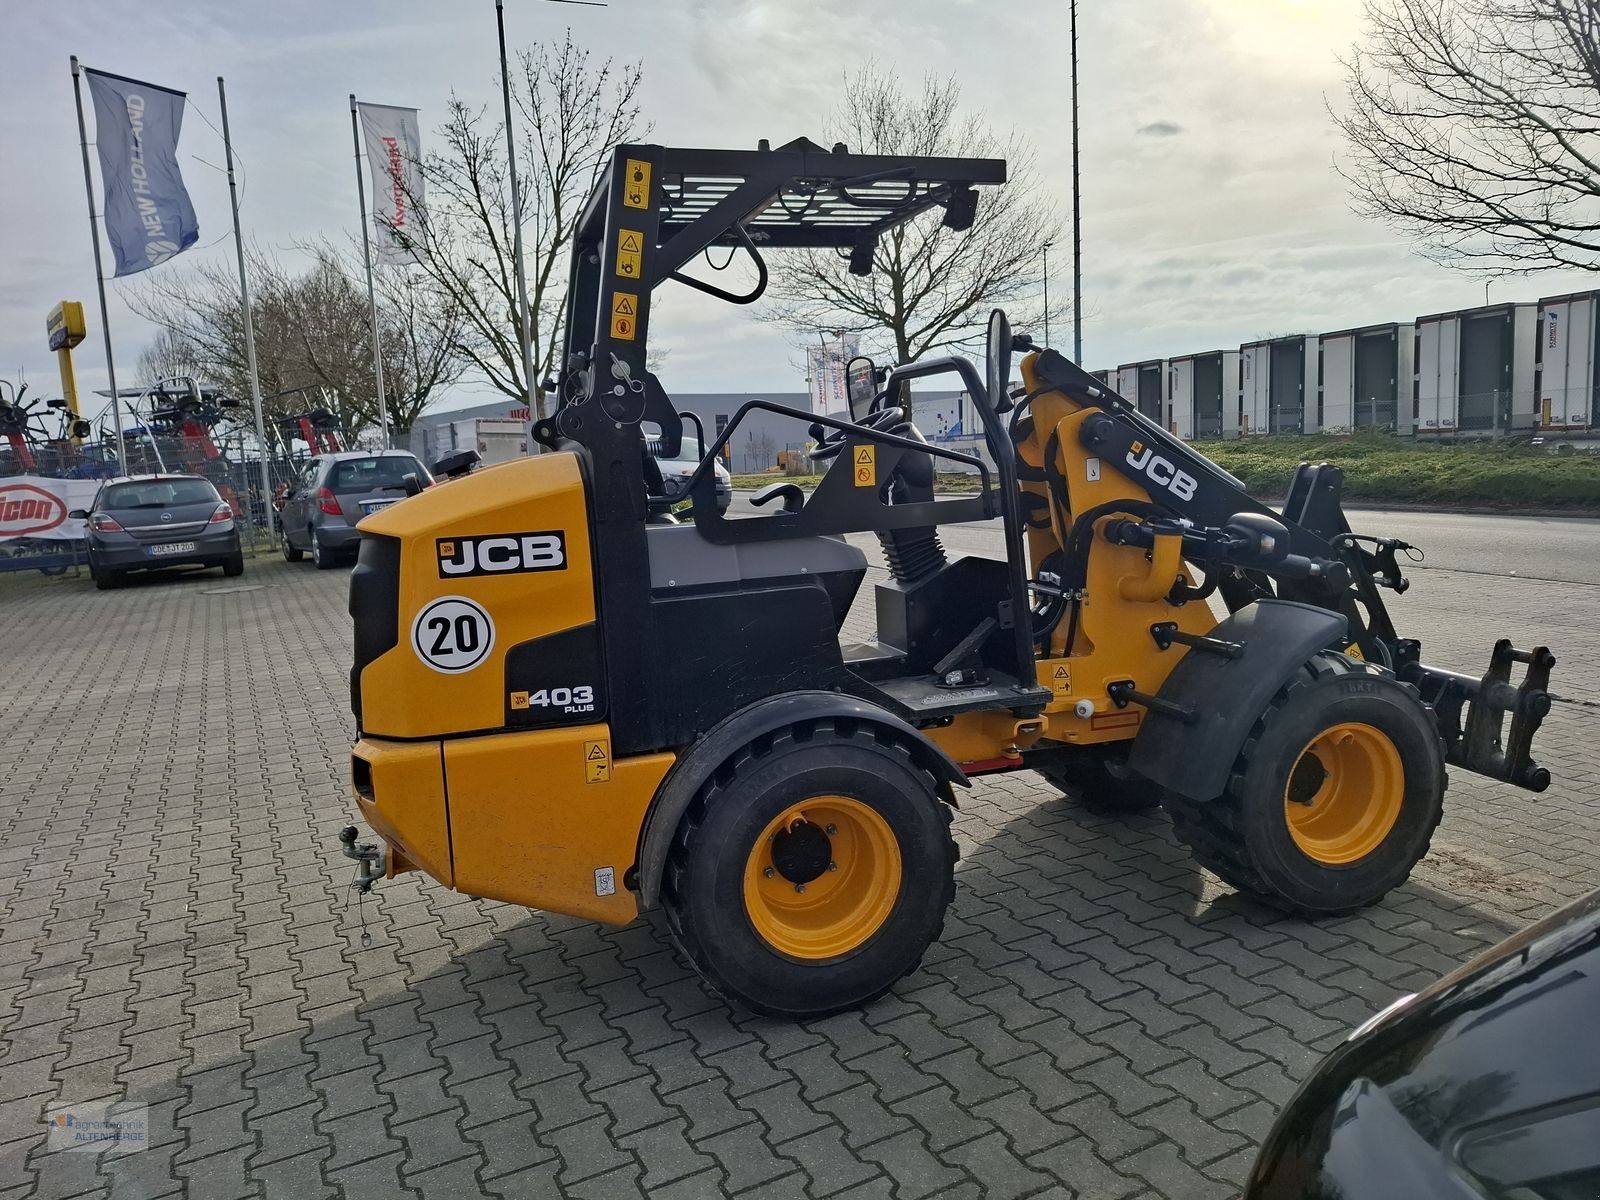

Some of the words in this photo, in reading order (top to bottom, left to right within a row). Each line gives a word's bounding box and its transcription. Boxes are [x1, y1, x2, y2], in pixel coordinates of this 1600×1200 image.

[126, 94, 152, 194] HOLLAND
[135, 197, 166, 237] NEW
[1126, 448, 1198, 501] JCB
[441, 536, 564, 574] JCB
[428, 615, 478, 655] 20
[529, 686, 594, 707] 403
[564, 705, 594, 713] PLUS
